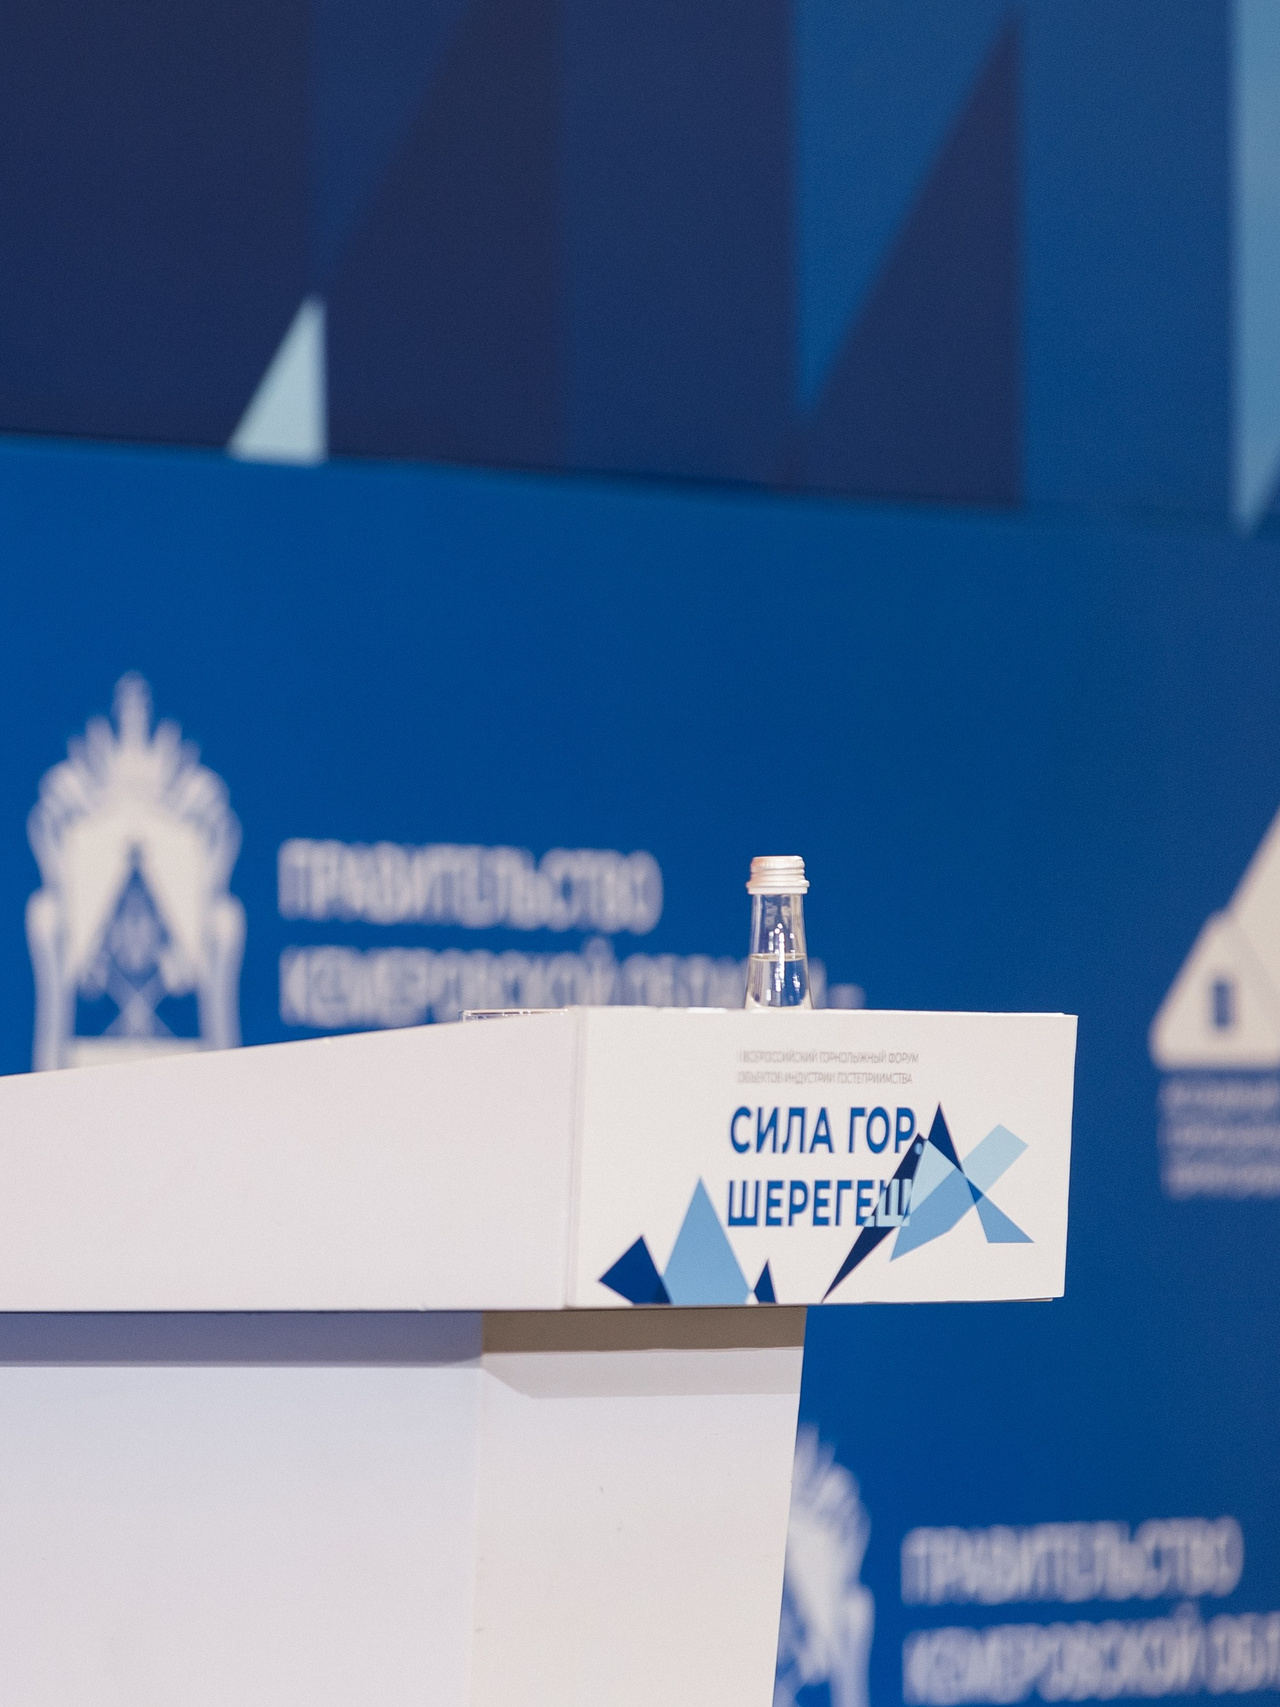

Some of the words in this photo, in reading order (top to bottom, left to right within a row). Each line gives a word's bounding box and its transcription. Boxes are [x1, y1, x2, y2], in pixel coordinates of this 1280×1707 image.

[820, 1050, 887, 1064] ГОРНОЛЫЖНЫЙ
[888, 1052, 920, 1064] ФОРУМ
[837, 1072, 913, 1084] ГОСТЕПРИИМСТВА
[729, 1105, 836, 1155] СИЛА
[726, 1178, 912, 1228] ШЕРЕГЕШ
